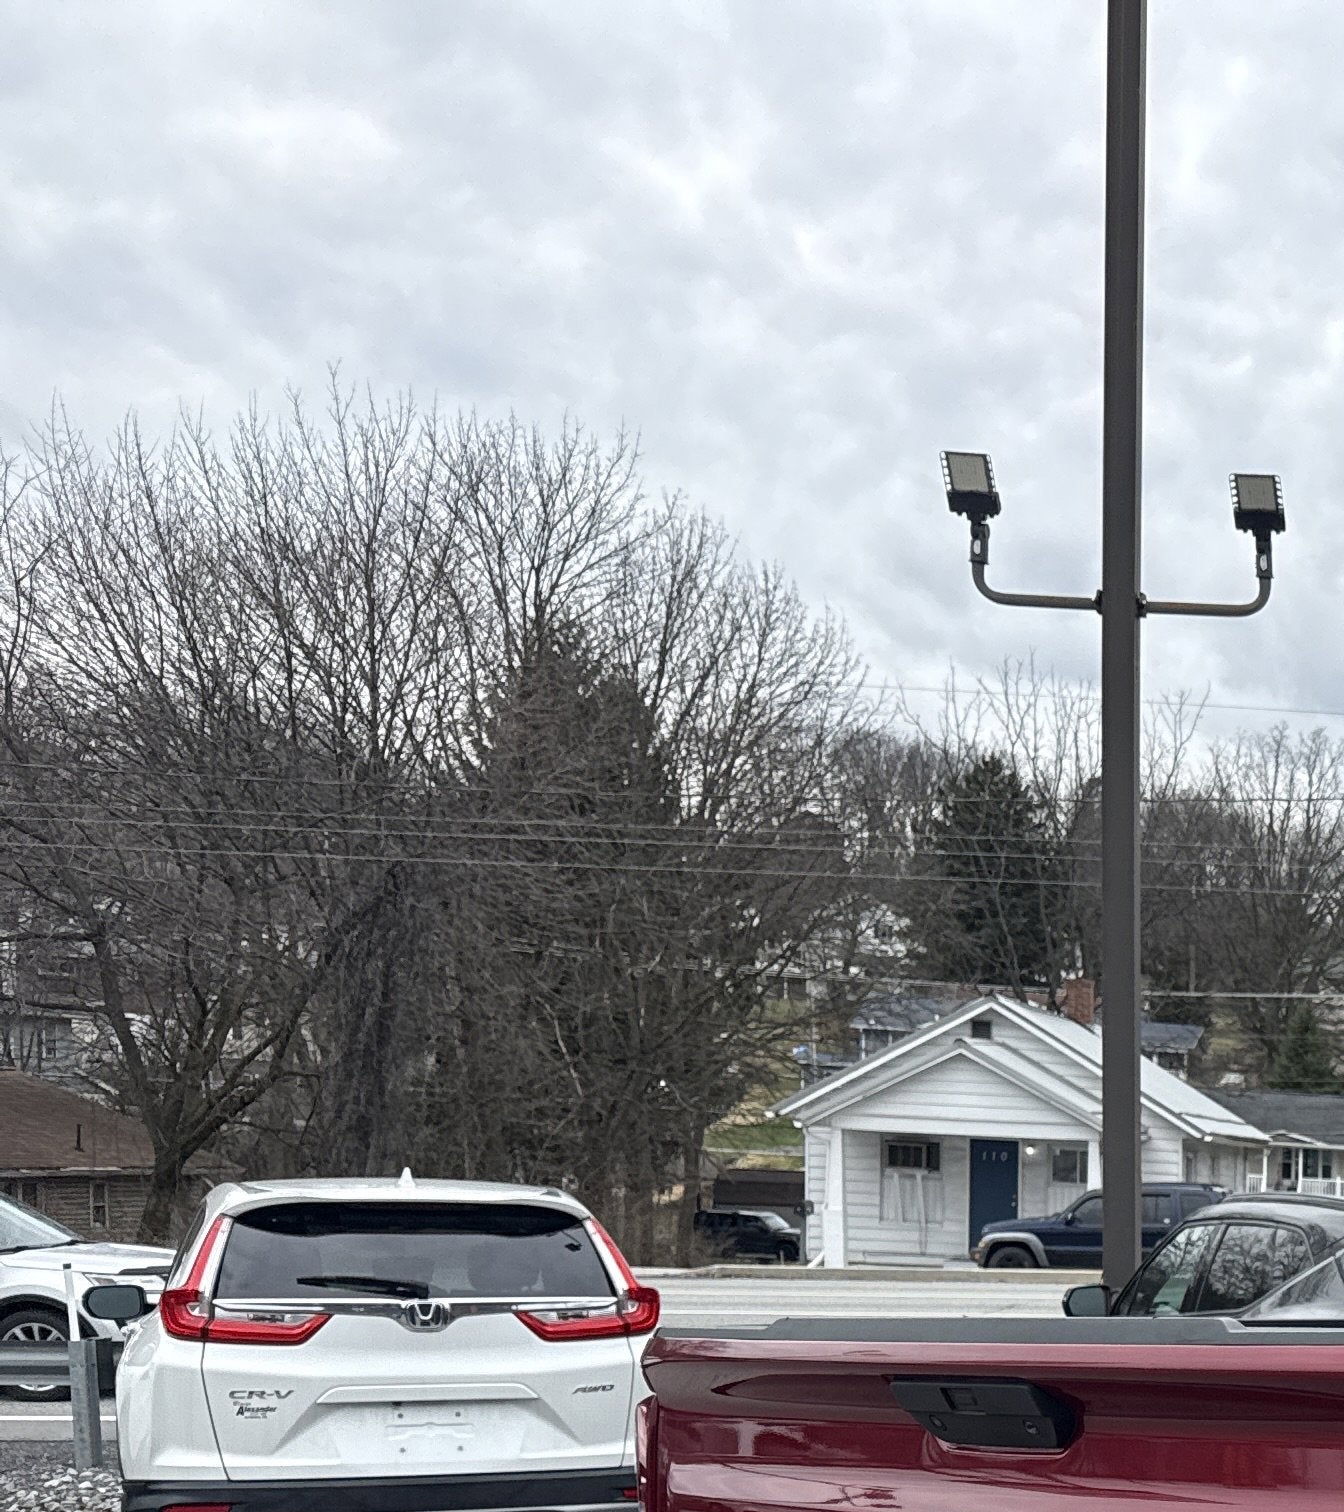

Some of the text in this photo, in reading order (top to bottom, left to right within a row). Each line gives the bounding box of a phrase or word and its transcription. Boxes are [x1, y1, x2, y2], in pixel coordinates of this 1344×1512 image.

[982, 1151, 1008, 1162] 110
[228, 1389, 295, 1400] CR-V
[571, 1384, 615, 1395] AWD
